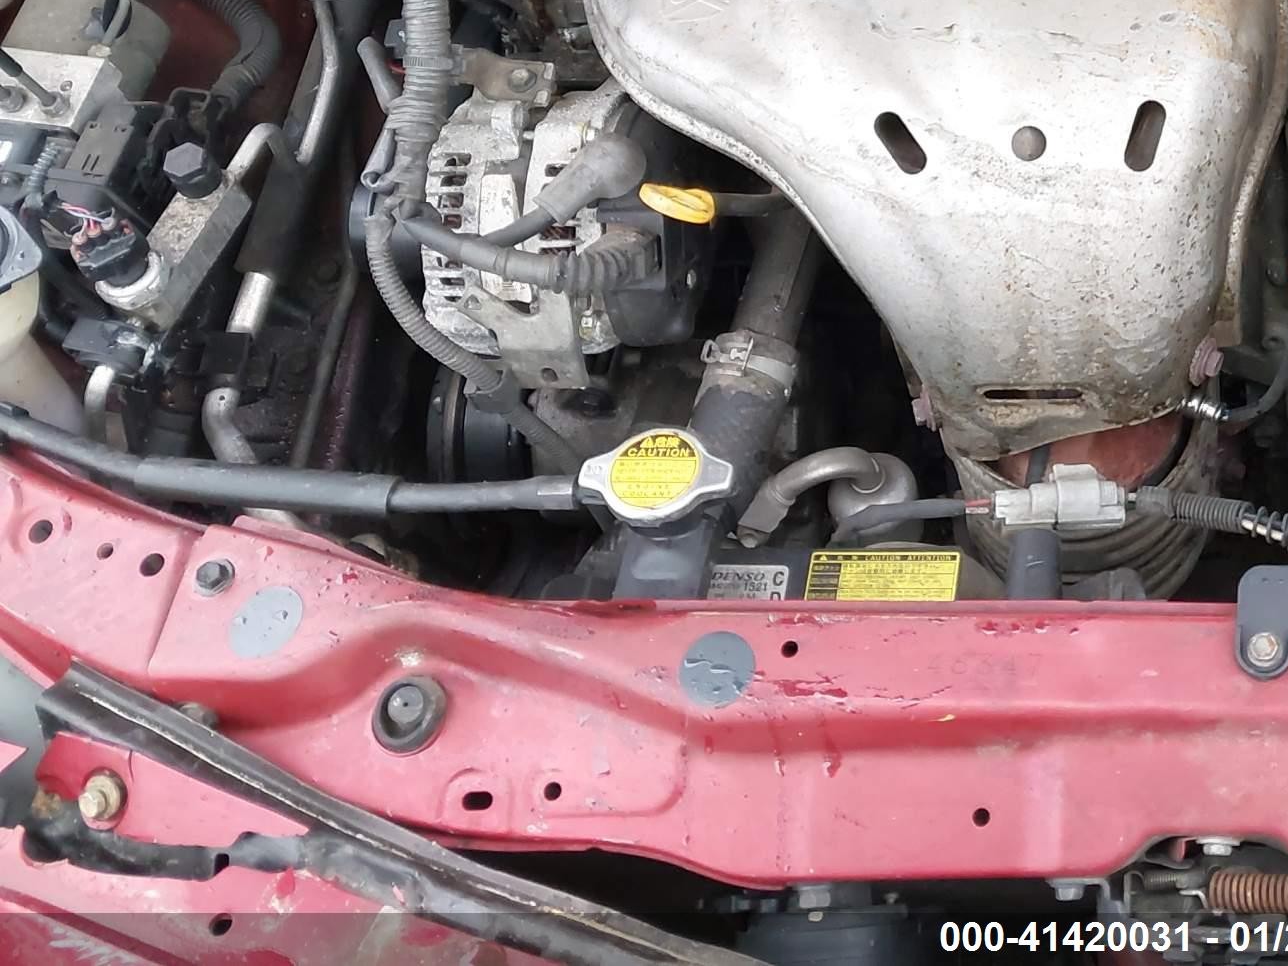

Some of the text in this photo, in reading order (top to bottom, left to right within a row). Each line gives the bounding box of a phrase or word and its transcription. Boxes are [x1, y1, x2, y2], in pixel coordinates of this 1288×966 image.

[626, 447, 691, 458] CAUTION
[864, 554, 901, 562] CAUTION
[906, 554, 952, 562] ATTENTION
[711, 571, 766, 582] DENSO
